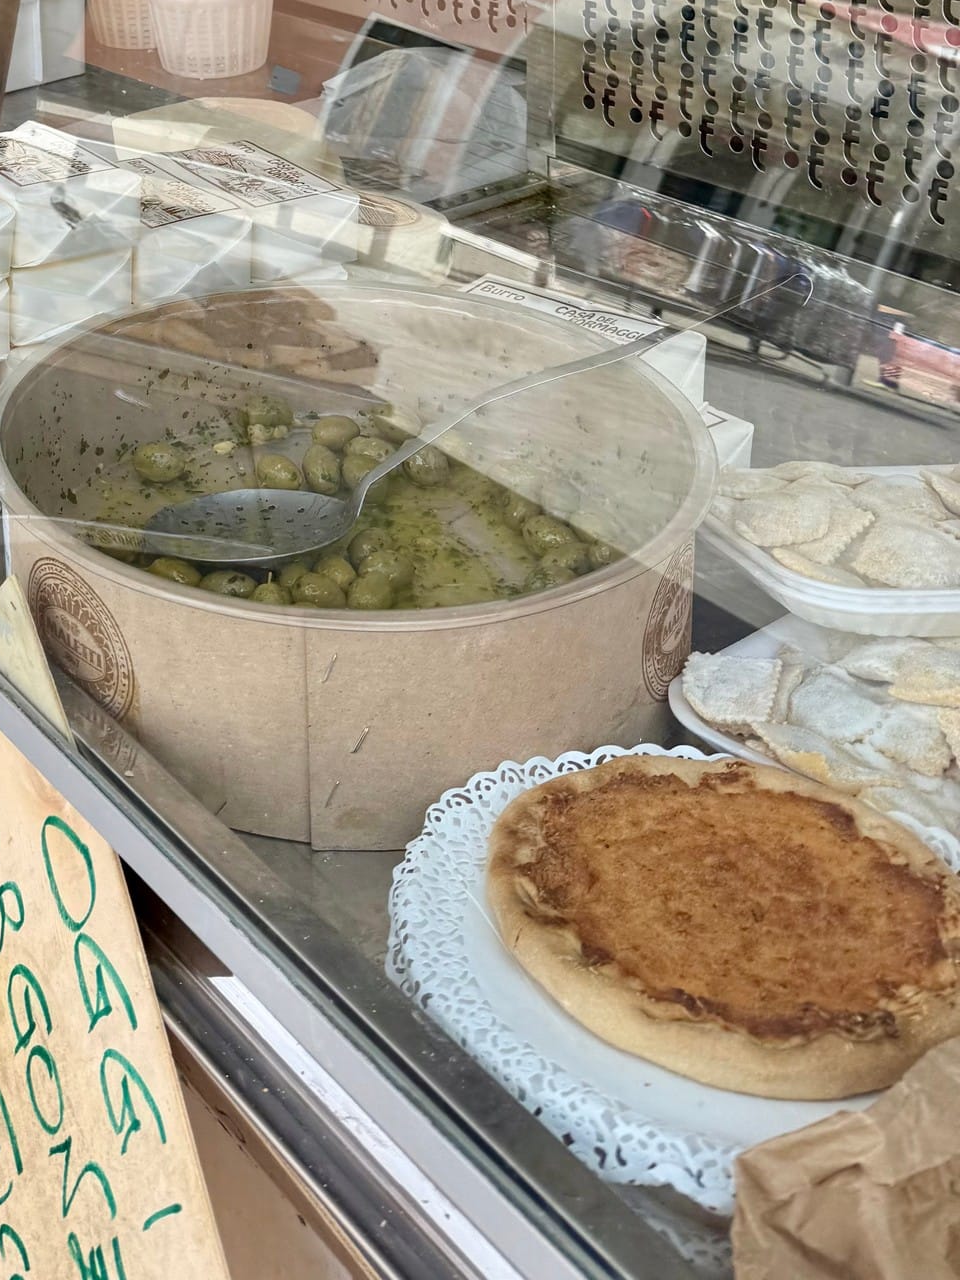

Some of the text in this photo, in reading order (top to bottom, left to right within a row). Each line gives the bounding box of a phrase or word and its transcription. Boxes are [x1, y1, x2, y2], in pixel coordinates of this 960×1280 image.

[478, 283, 526, 302] Burro
[554, 306, 619, 326] CASA DEL
[41, 815, 183, 1232] OGGI
